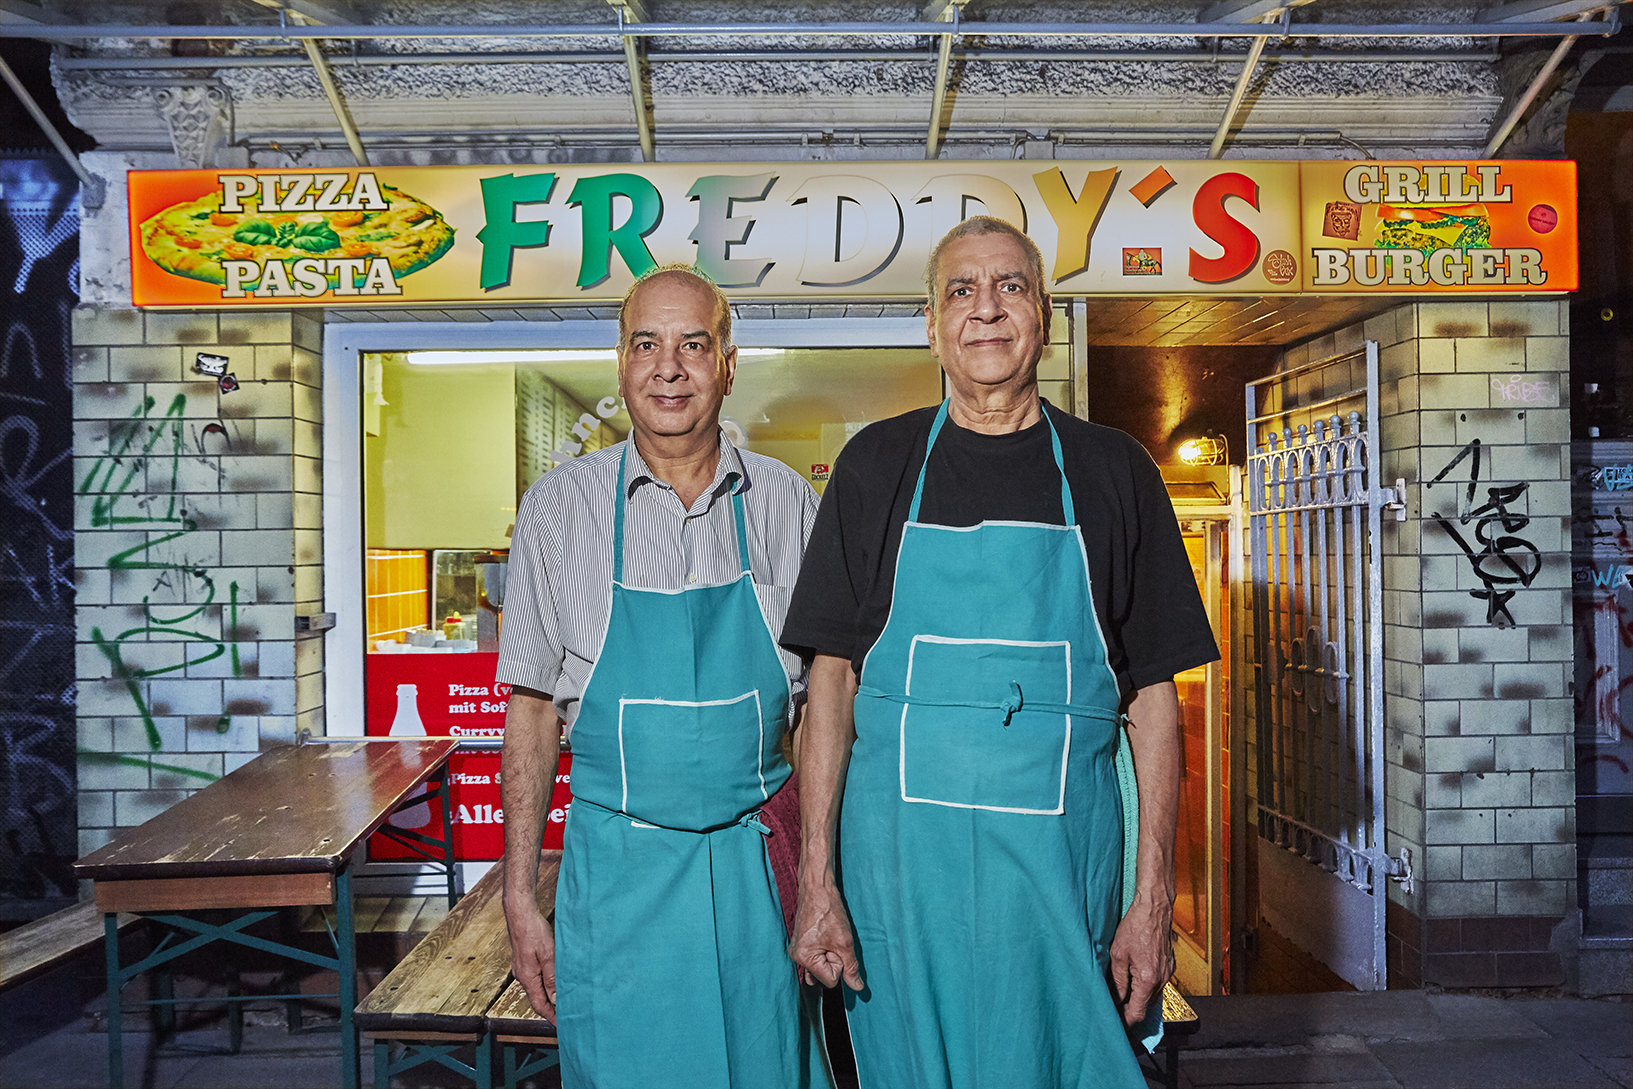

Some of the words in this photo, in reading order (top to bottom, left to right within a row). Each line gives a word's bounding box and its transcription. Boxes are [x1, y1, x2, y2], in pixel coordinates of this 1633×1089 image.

[218, 173, 389, 213] PIZZA
[1343, 165, 1513, 204] GRILL
[221, 258, 403, 298] PASTA
[1312, 248, 1548, 286] BURGER
[448, 684, 489, 696] Pizza
[448, 702, 477, 713] mit
[480, 701, 508, 713] Sof
[448, 773, 491, 784] Pizza
